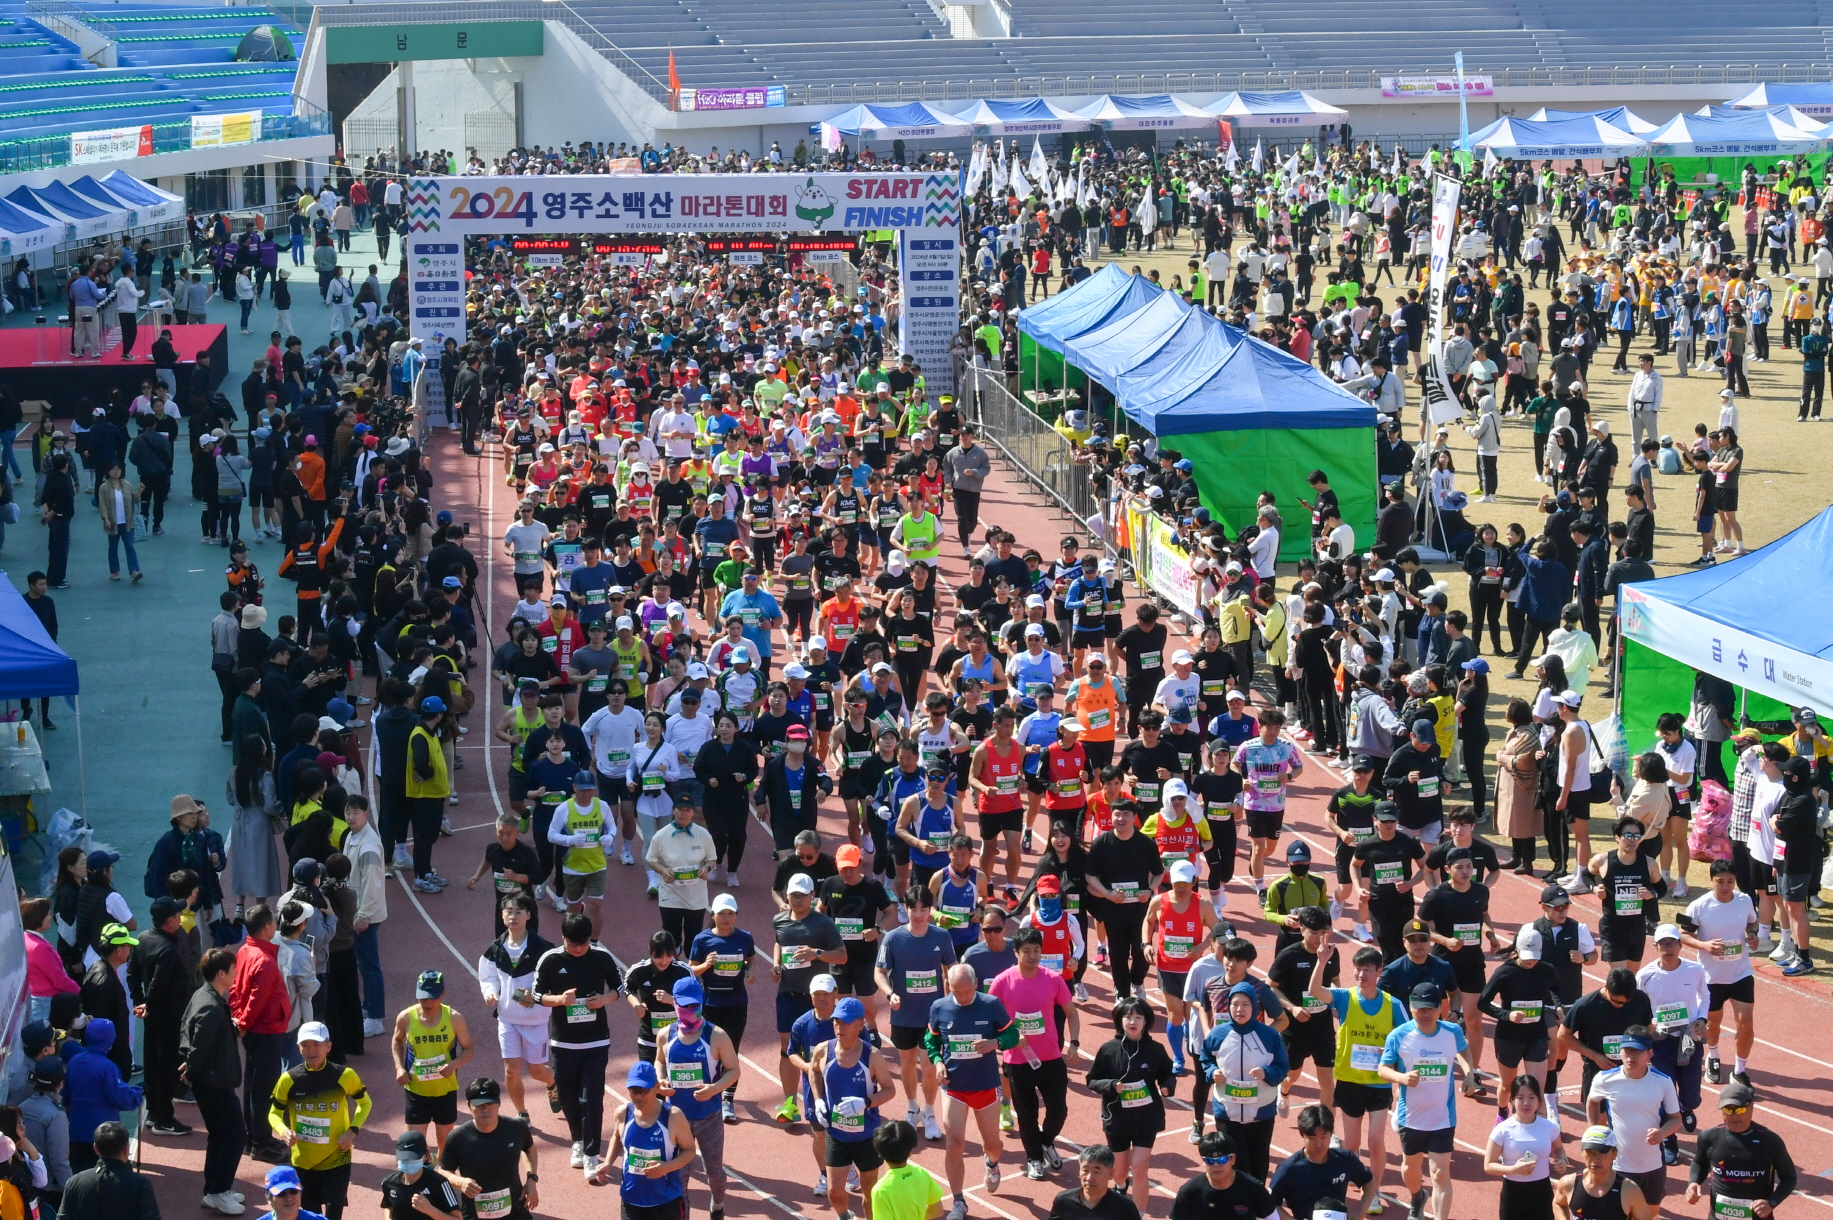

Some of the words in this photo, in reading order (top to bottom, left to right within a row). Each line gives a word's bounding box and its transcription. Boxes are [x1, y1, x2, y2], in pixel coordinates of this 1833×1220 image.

[697, 94, 716, 105] H2O
[718, 93, 745, 105] 마라톤
[1519, 147, 1550, 156] 5km코스
[1551, 148, 1567, 156] 메달,
[1569, 147, 1603, 155] 간식배부처
[1695, 145, 1725, 153] 5km코스
[1726, 145, 1742, 153] 메달,
[1743, 144, 1777, 152] 간식배부처
[845, 178, 924, 200] START
[448, 186, 538, 227] 2024
[542, 191, 673, 219] 영주소백산
[680, 194, 787, 218] 마라톤대회
[844, 206, 924, 228] FINISH
[625, 222, 663, 230] YEONGJU
[531, 256, 548, 265] 10km
[548, 256, 560, 264] 코스
[625, 255, 638, 263] 코스
[733, 254, 746, 263] 하프
[746, 254, 759, 262] 코스
[812, 253, 827, 261] 5km
[565, 556, 574, 564] 23
[1782, 669, 1798, 683] Water
[1799, 675, 1813, 689] Station
[572, 820, 599, 829] 영주마라톤
[1380, 870, 1398, 878] 3072
[839, 926, 857, 934] 3854
[1459, 932, 1477, 940] 3282
[912, 980, 932, 988] 3412
[1661, 1012, 1680, 1021] 3097
[1020, 1021, 1039, 1029] 3320
[414, 1034, 448, 1045] 영주마라톤
[1358, 1054, 1378, 1063] 2324
[676, 1072, 695, 1080] 3961
[1419, 1067, 1441, 1076] 3144
[1125, 1090, 1145, 1100] 4770
[1231, 1089, 1252, 1097] 4769
[302, 1126, 323, 1137] 3483
[633, 1158, 647, 1167] 397
[1725, 1170, 1766, 1178] MOBILITY
[482, 1200, 505, 1211] 3697
[1721, 1207, 1745, 1217] 4038
